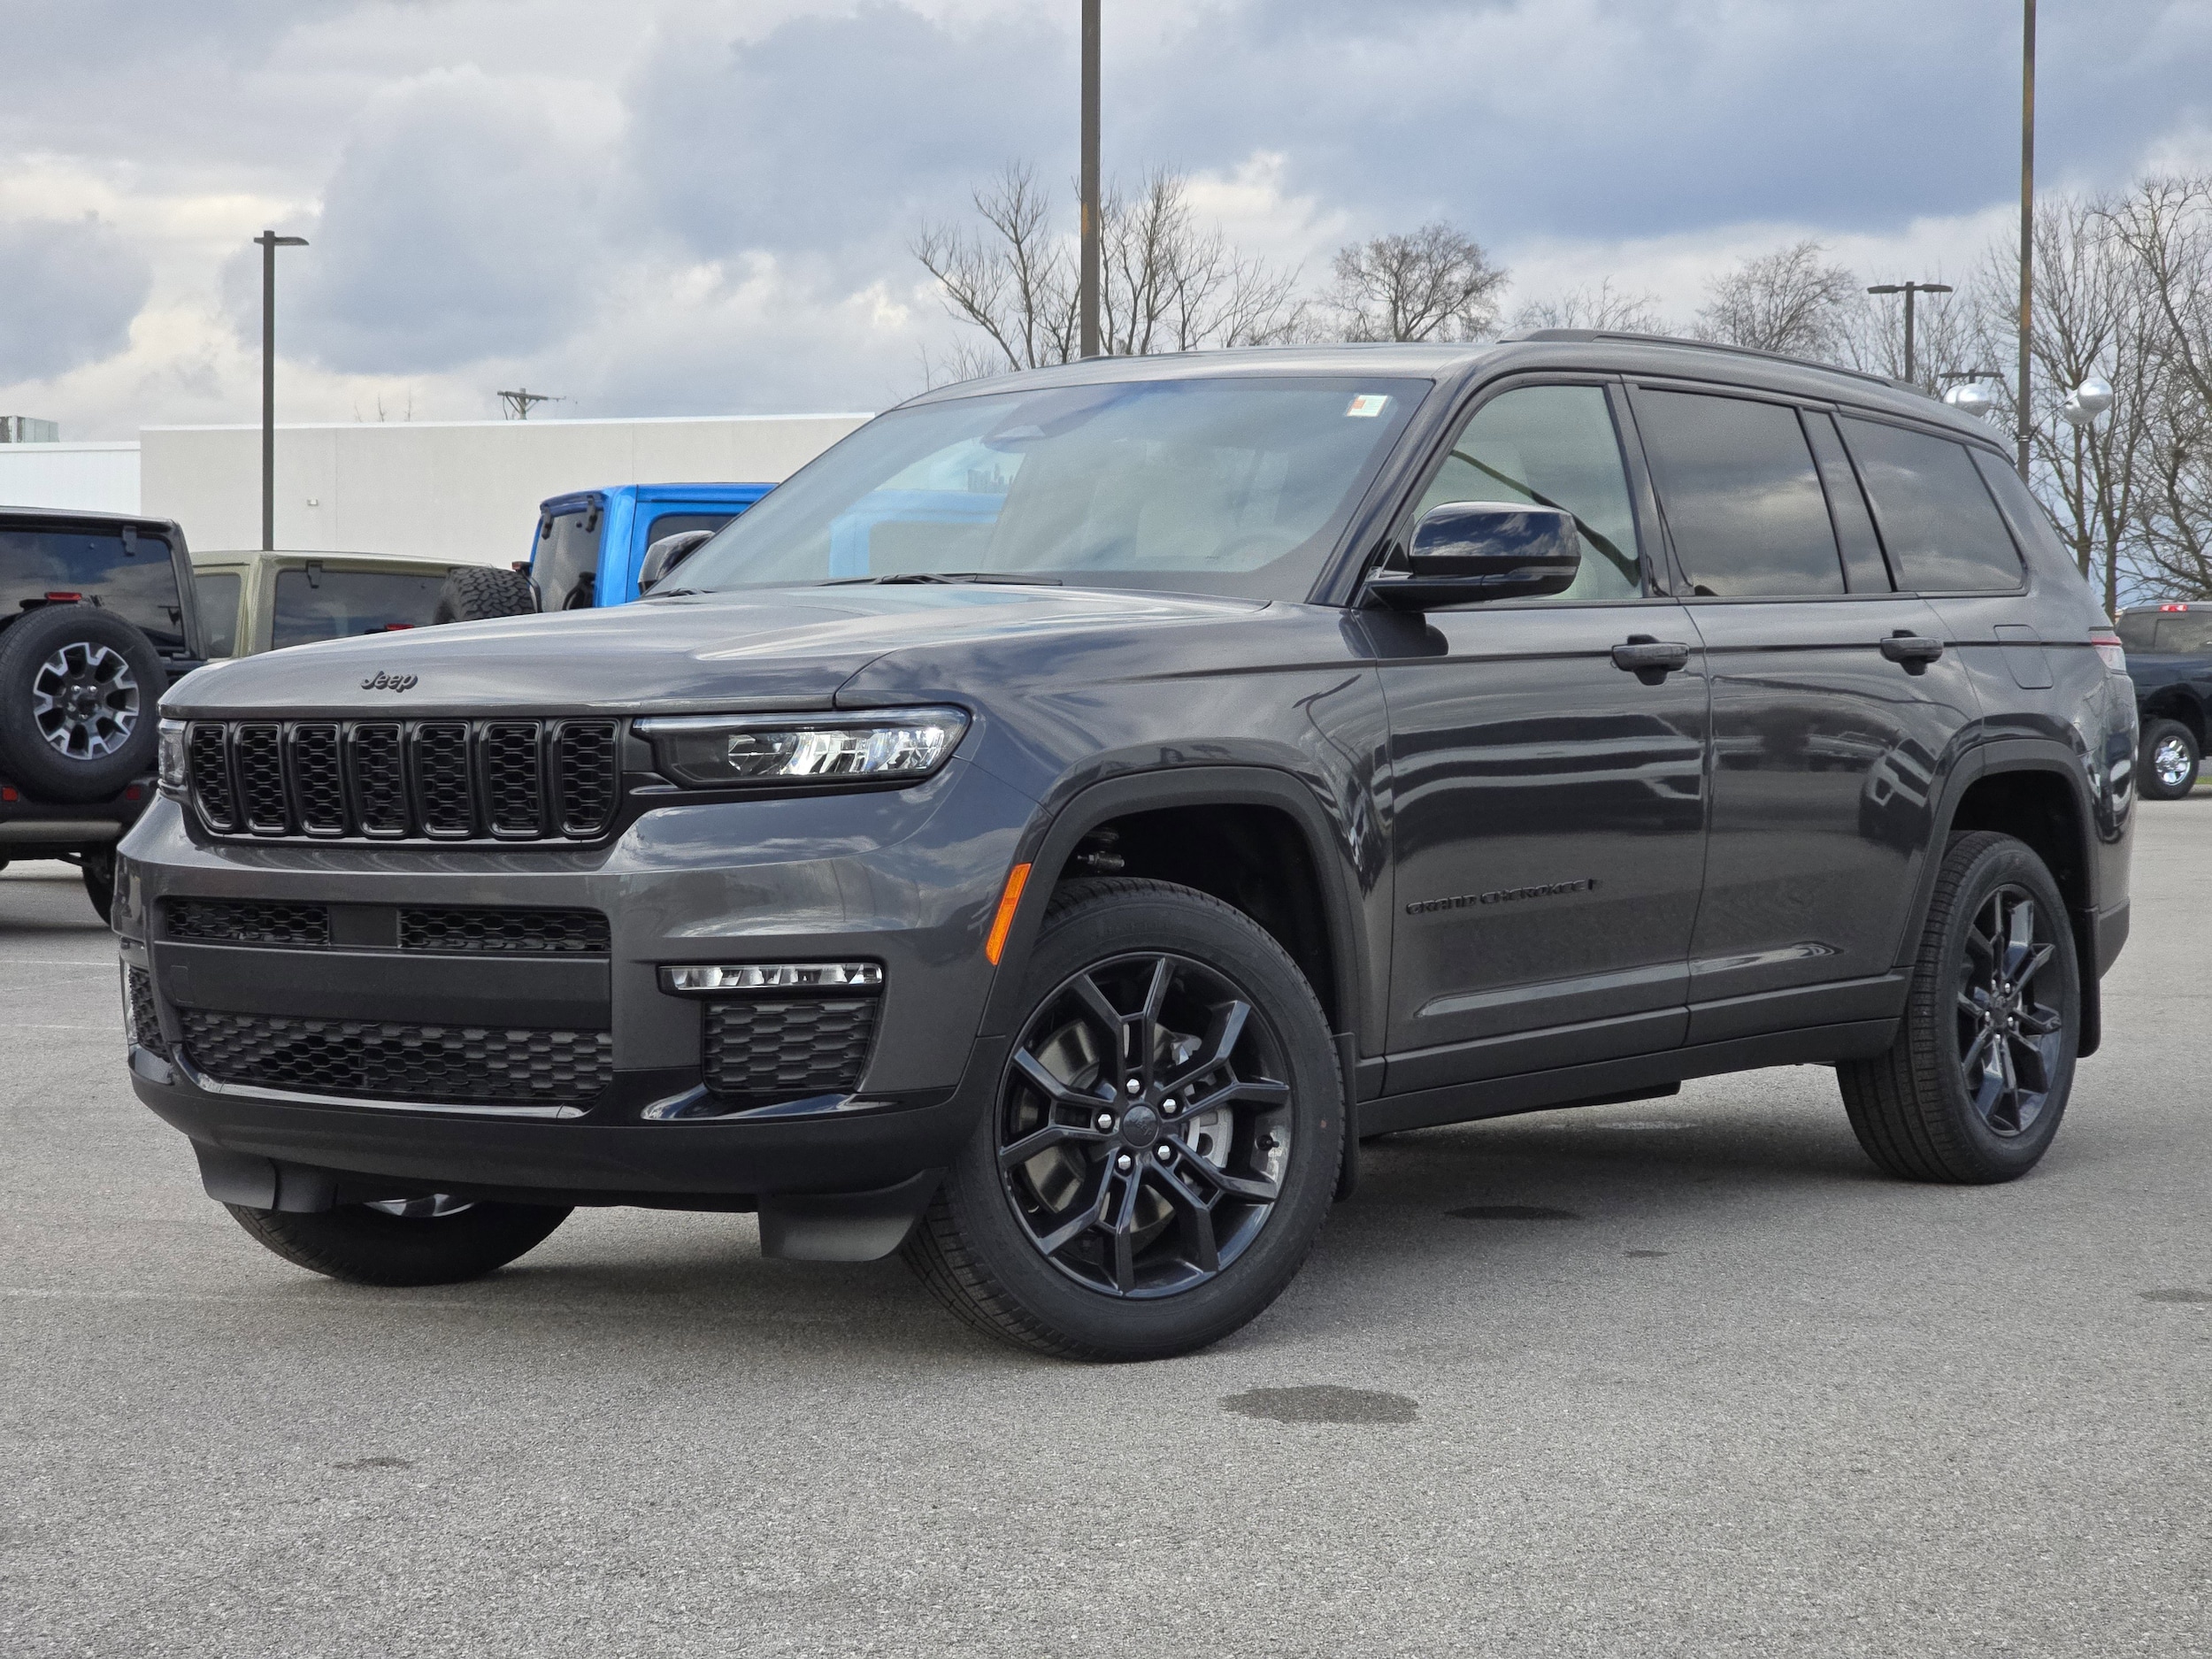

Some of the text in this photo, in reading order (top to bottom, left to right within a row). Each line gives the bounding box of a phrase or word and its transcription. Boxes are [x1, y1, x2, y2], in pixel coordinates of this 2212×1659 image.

[360, 670, 419, 693] Jeep
[1405, 895, 1477, 915] GRAND
[1479, 879, 1586, 904] CHEROKEE
